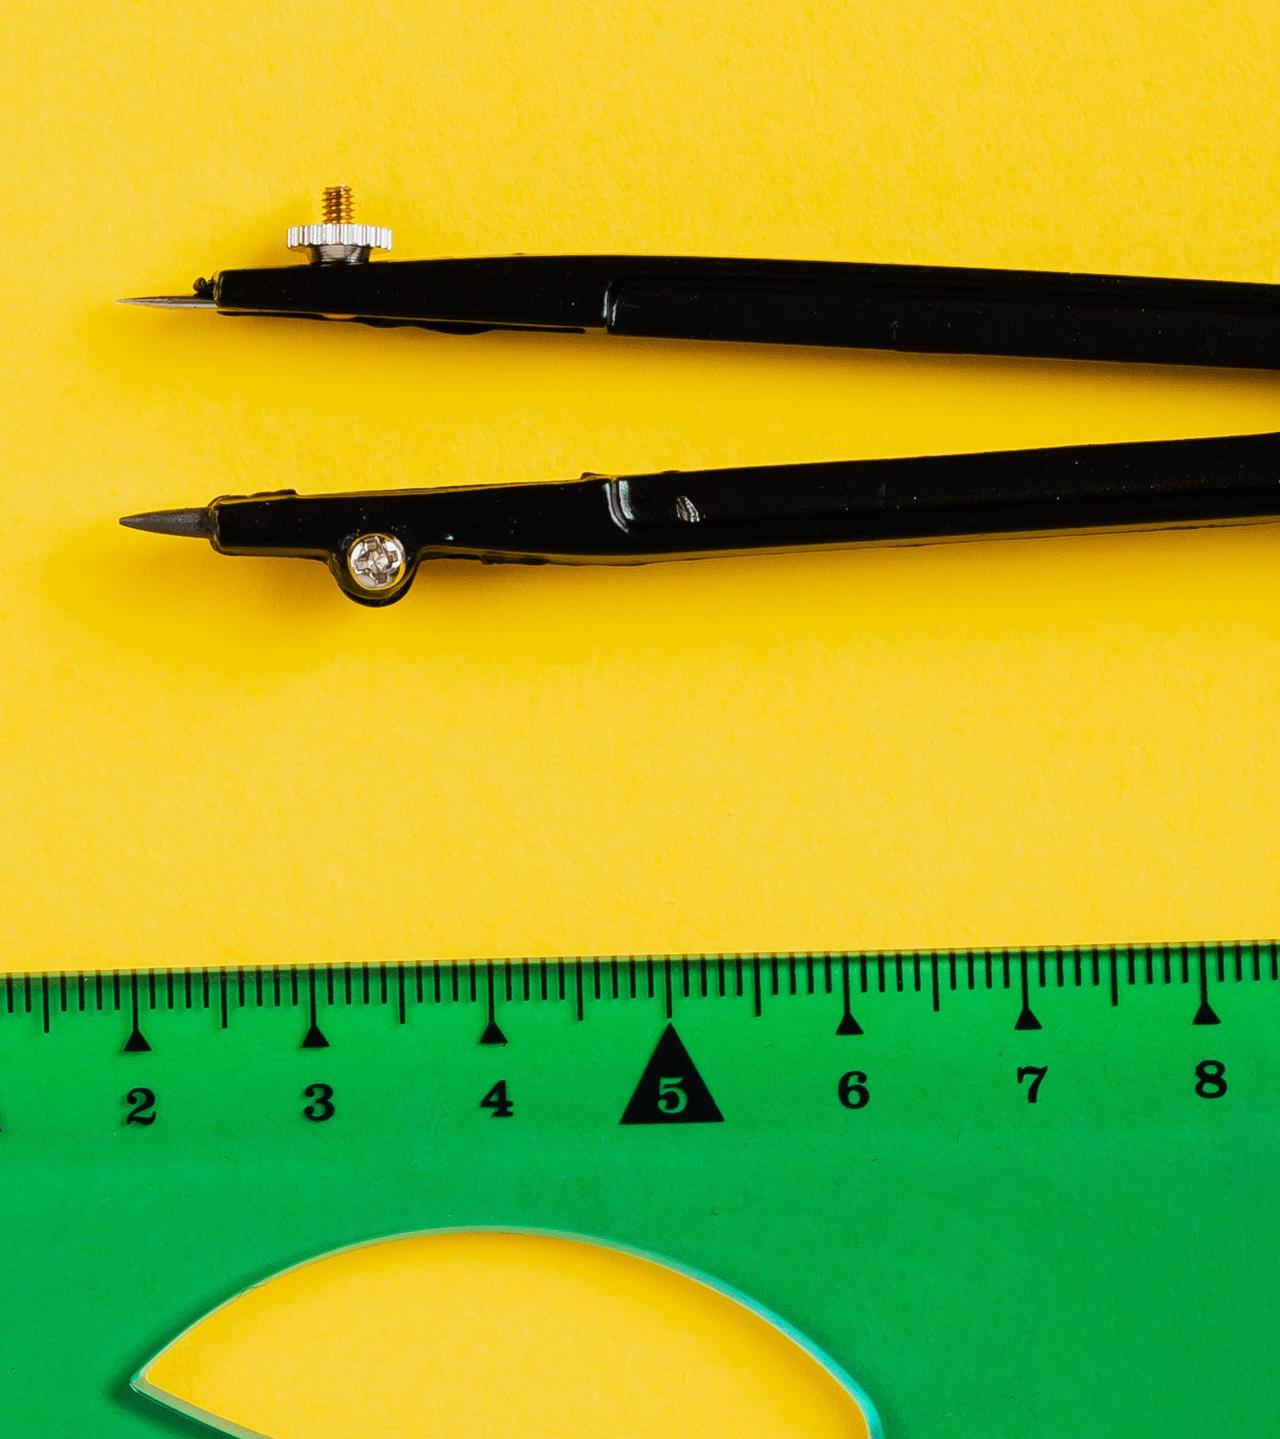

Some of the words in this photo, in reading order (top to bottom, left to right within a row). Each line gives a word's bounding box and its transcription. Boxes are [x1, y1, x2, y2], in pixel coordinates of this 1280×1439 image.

[124, 1086, 158, 1128] 2
[302, 1082, 337, 1124] 3
[479, 1078, 515, 1119] 4
[656, 1075, 689, 1115] 5
[836, 1069, 871, 1111] 6
[1015, 1064, 1049, 1105] 7
[1193, 1058, 1229, 1101] 8
